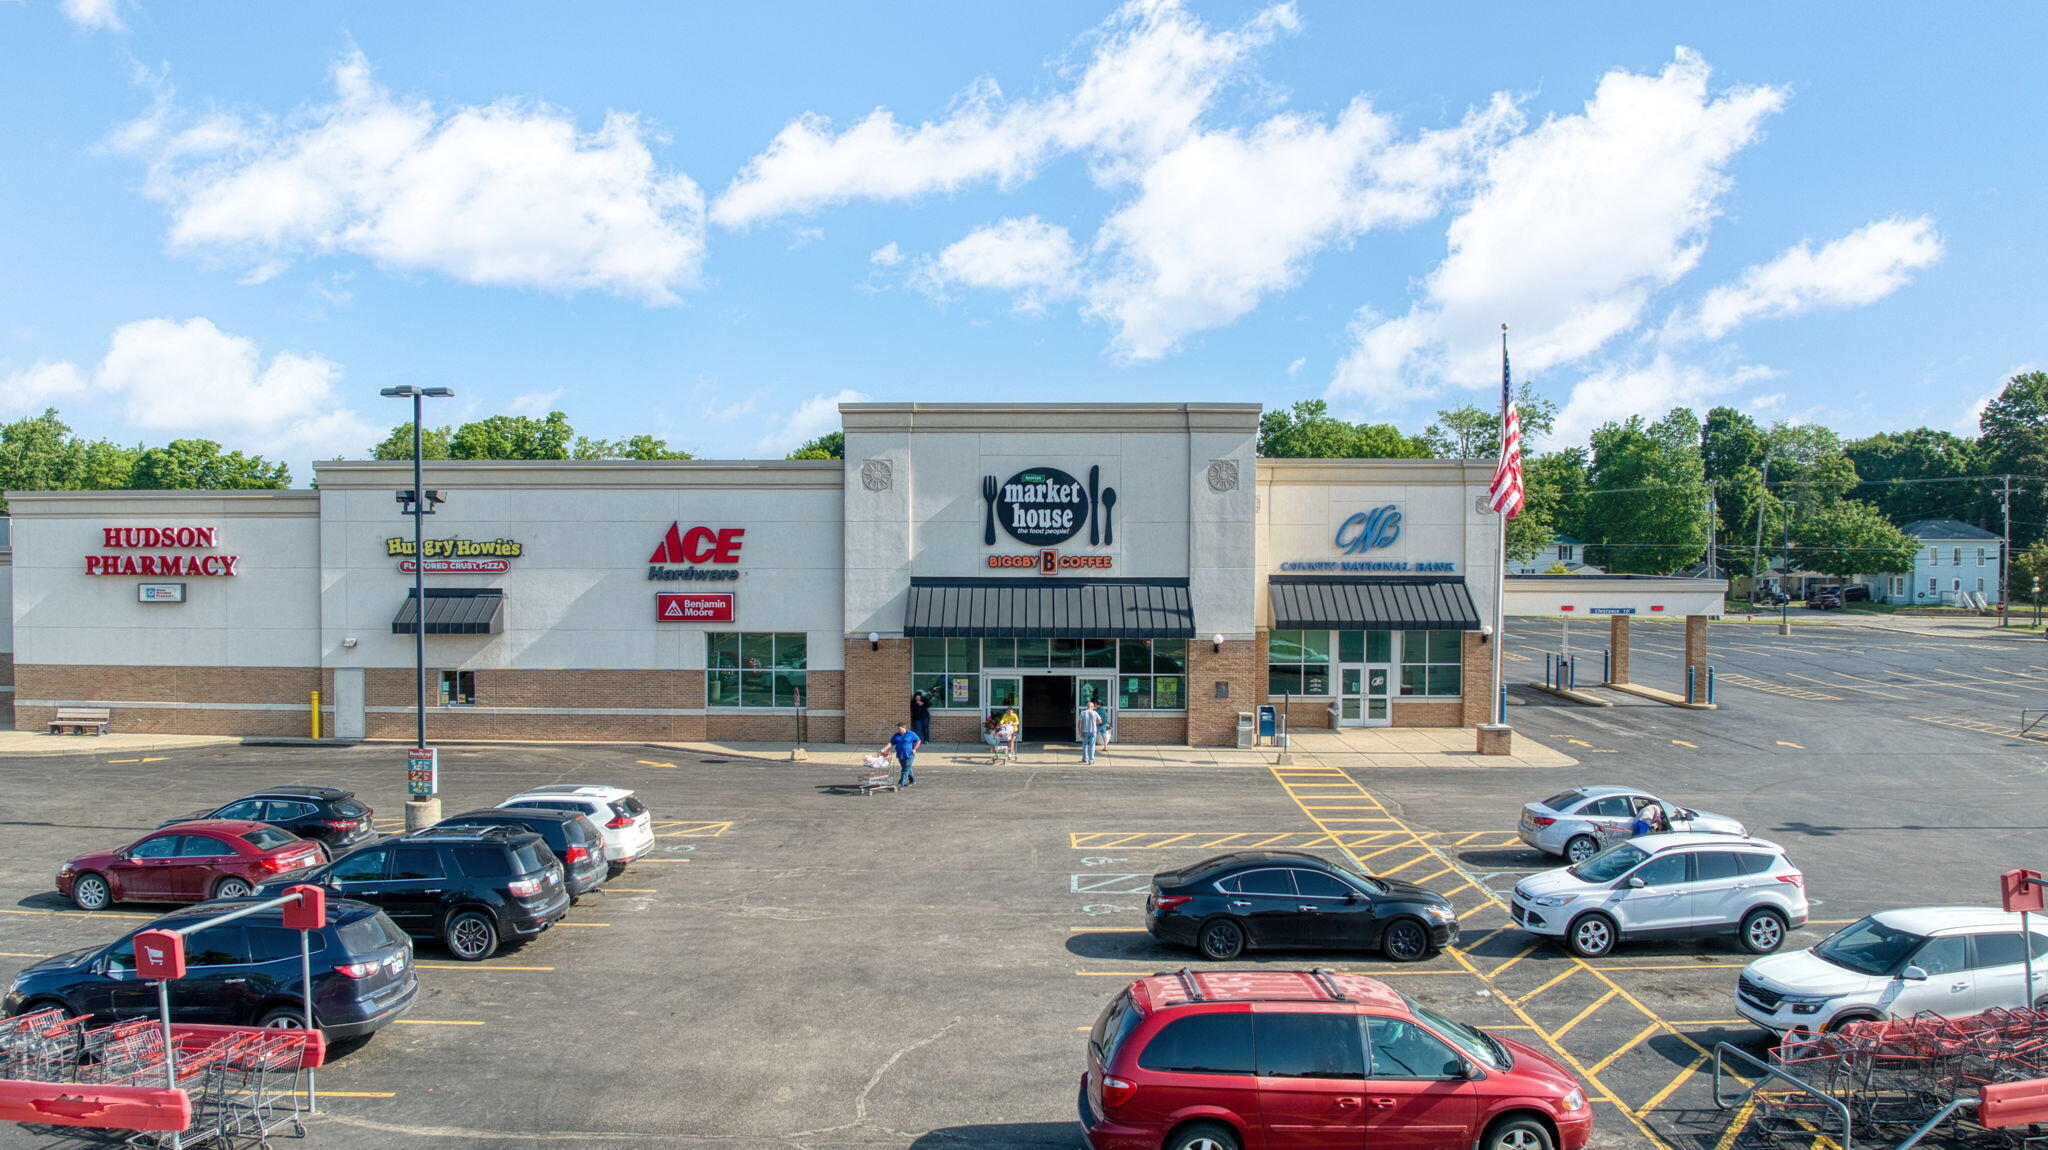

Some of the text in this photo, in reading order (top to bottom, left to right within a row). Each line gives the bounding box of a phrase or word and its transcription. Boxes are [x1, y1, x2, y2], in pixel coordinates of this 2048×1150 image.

[1004, 478, 1080, 503] market
[1012, 503, 1074, 528] house
[103, 527, 216, 547] HUDSON
[648, 520, 745, 564] ACE
[456, 538, 521, 557] Howie's
[85, 555, 238, 576] PHARMACY
[403, 562, 448, 570] FLORED
[479, 562, 505, 570] PIZZA
[988, 555, 1039, 568] BIGGBY
[1059, 555, 1112, 568] COFFEE
[1280, 561, 1456, 573] COUNTY NATIONAL BANK
[648, 565, 740, 581] Hardware
[684, 599, 726, 610] Benjamin
[684, 608, 714, 616] Moore
